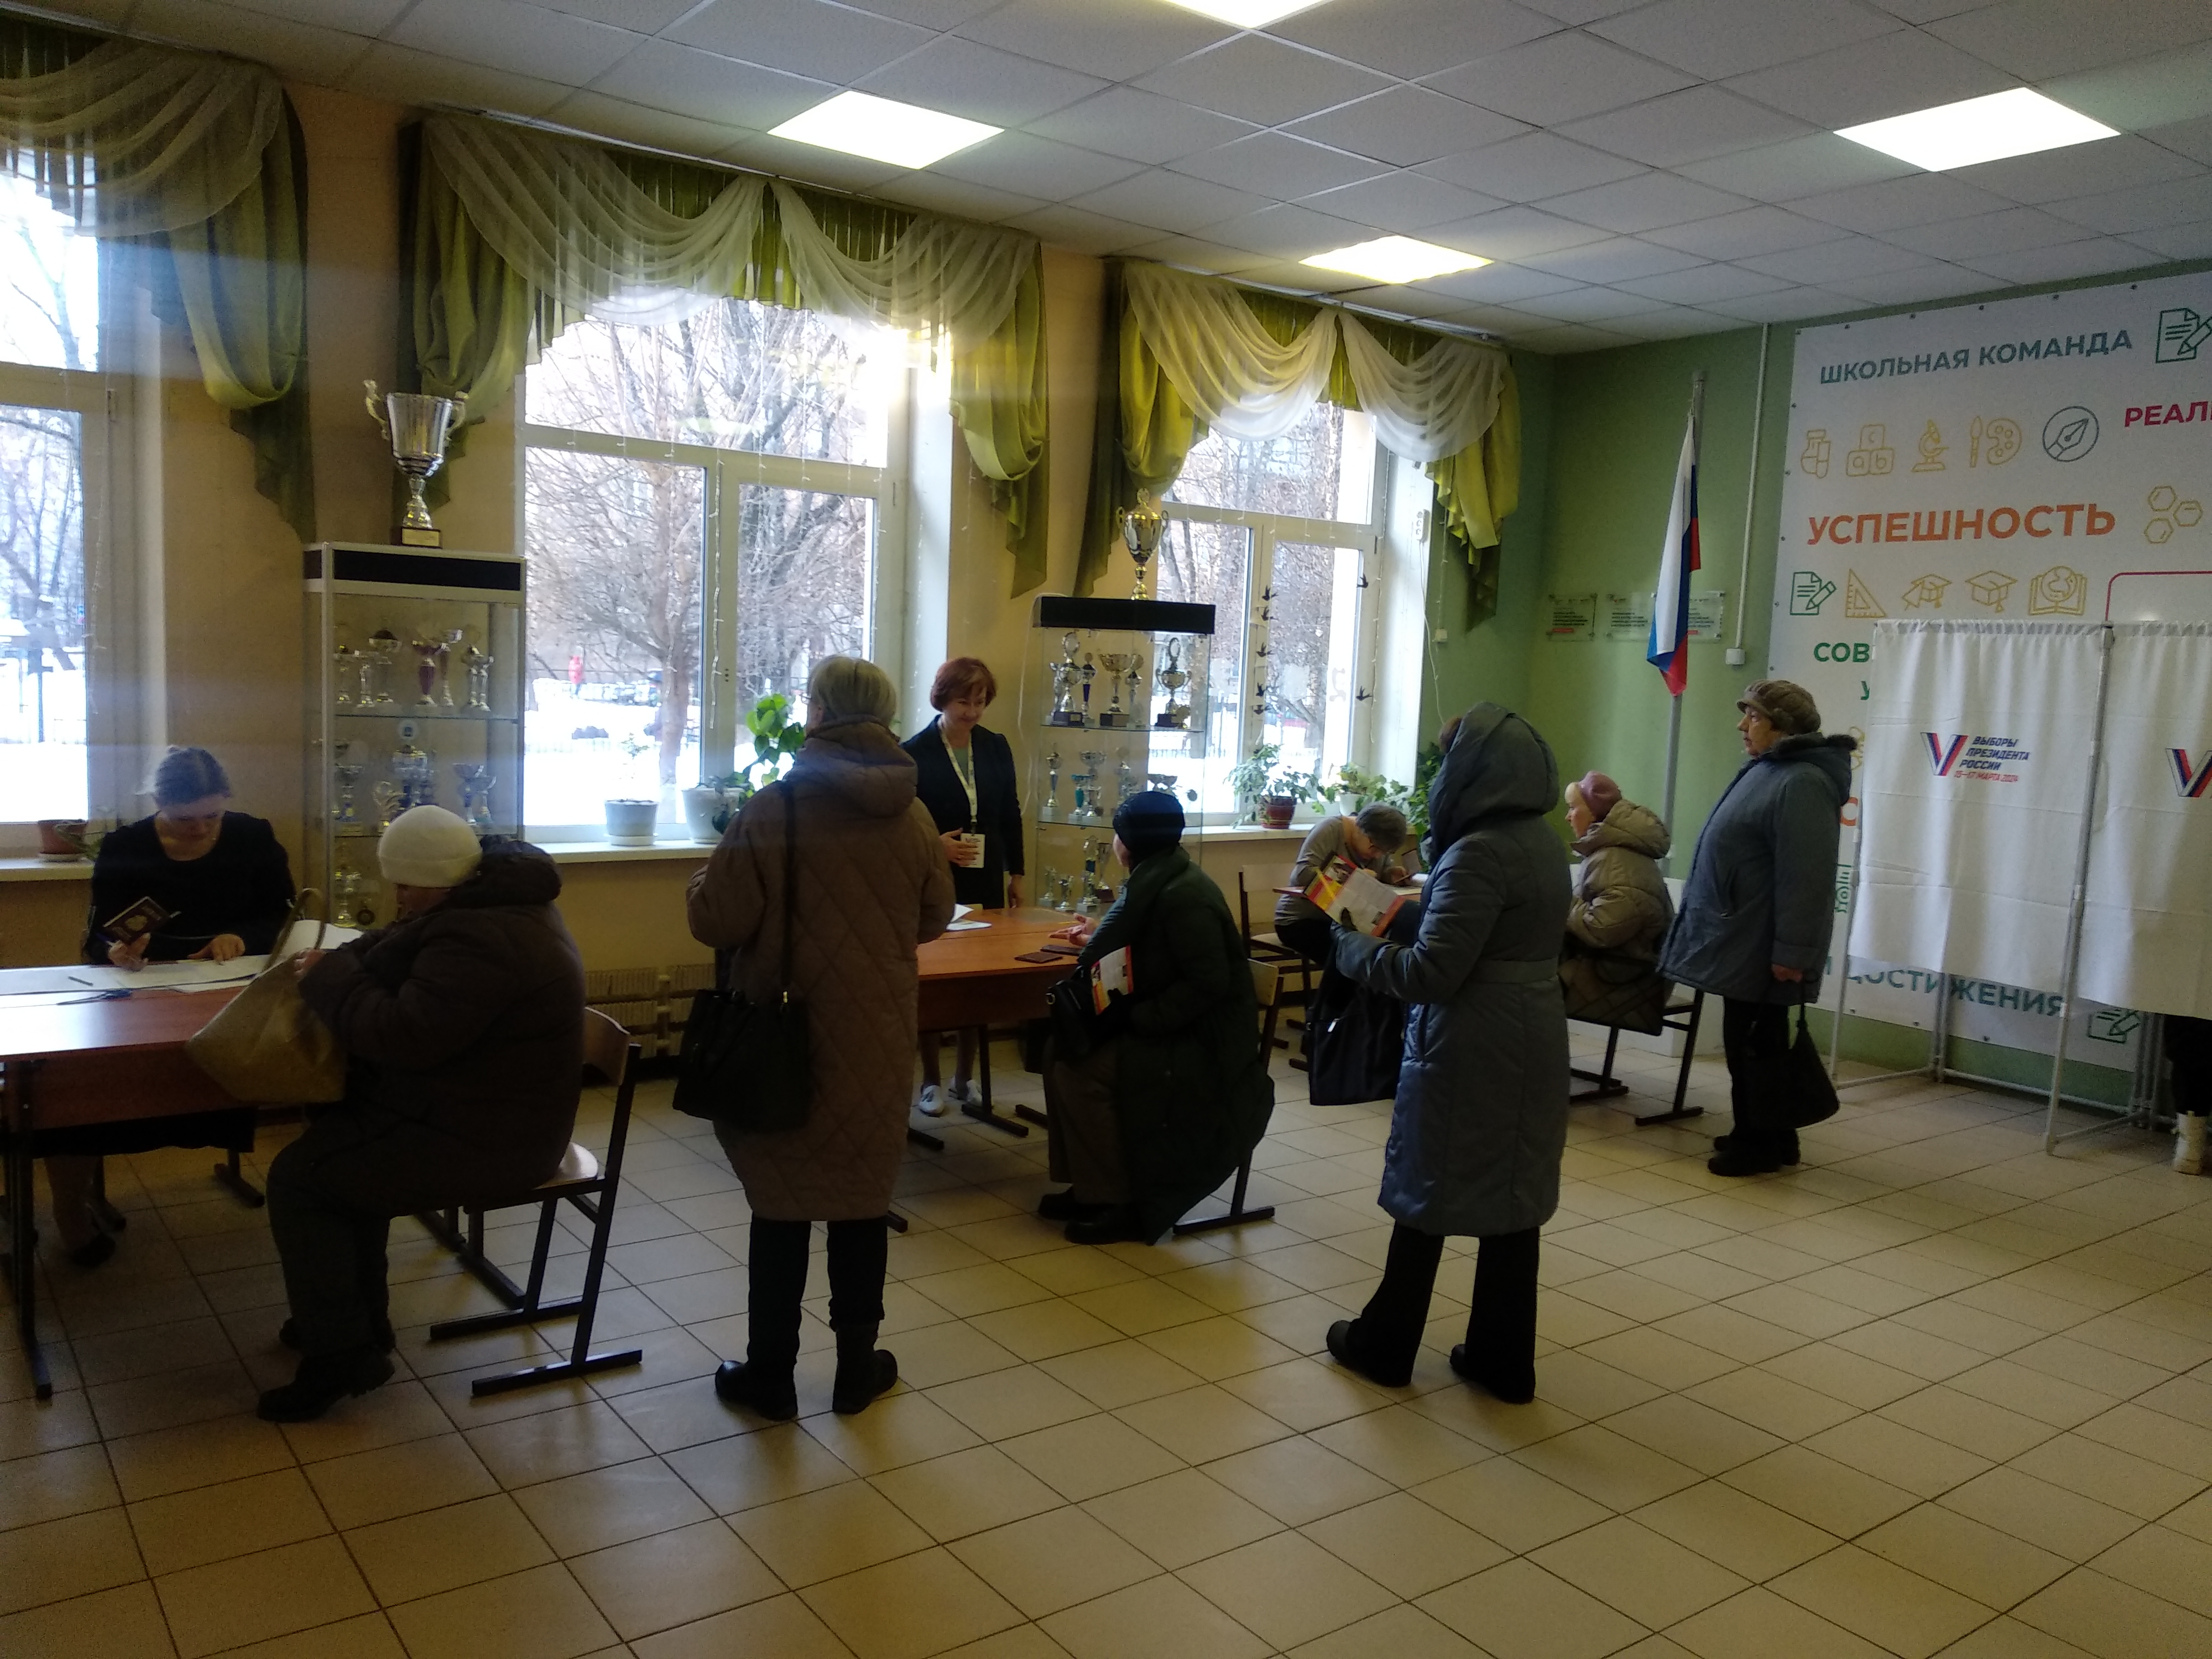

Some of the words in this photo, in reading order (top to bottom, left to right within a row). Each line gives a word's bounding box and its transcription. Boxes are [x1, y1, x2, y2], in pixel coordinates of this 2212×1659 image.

[1820, 348, 1970, 384] ШКОЛЬНАЯ
[1979, 330, 2132, 366] КОМАНДА
[2124, 401, 2212, 427] РЕАЛ
[1807, 504, 2115, 545] УСПЕШНОСТЬ
[1965, 748, 2030, 760] ПРЕЗИДЕНТА
[1971, 735, 2018, 748] ВЫБОРЫ
[1958, 759, 2002, 771] РОССИИ
[1847, 969, 2064, 1016] ОСТИЖЕНИЯ
